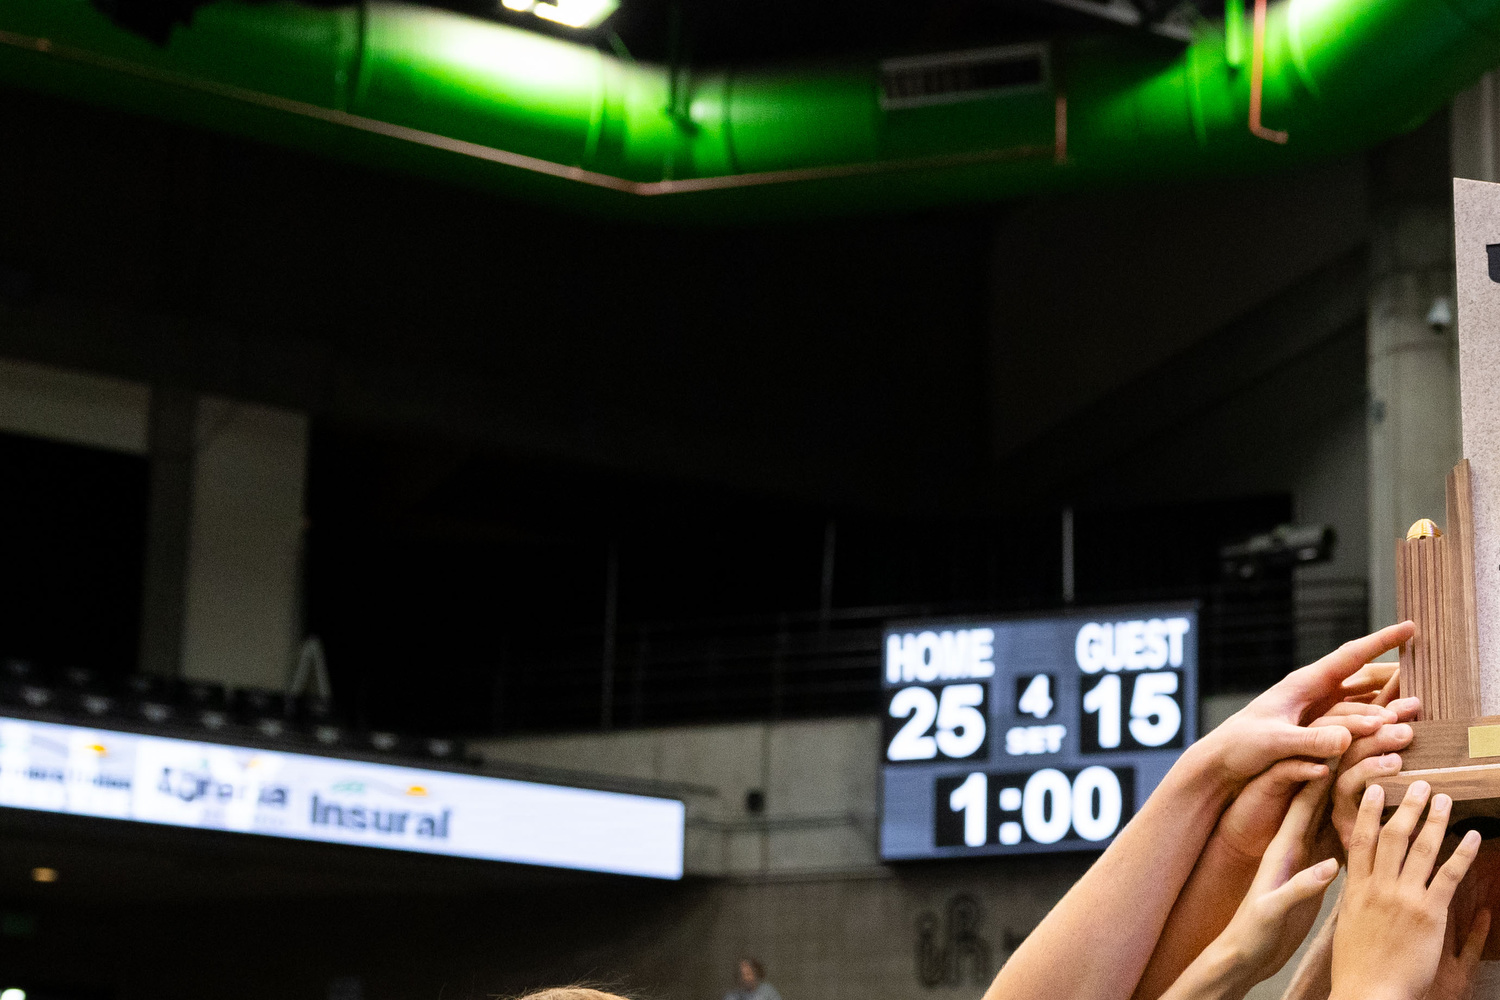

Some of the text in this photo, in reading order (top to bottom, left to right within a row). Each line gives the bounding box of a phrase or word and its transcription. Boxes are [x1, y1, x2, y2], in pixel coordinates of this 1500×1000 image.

[886, 628, 995, 683] HOME
[1075, 618, 1190, 674] GUEST
[887, 684, 986, 761] 25
[1018, 673, 1053, 719] 4
[1083, 671, 1182, 749] 15
[950, 766, 1122, 847] 1:00
